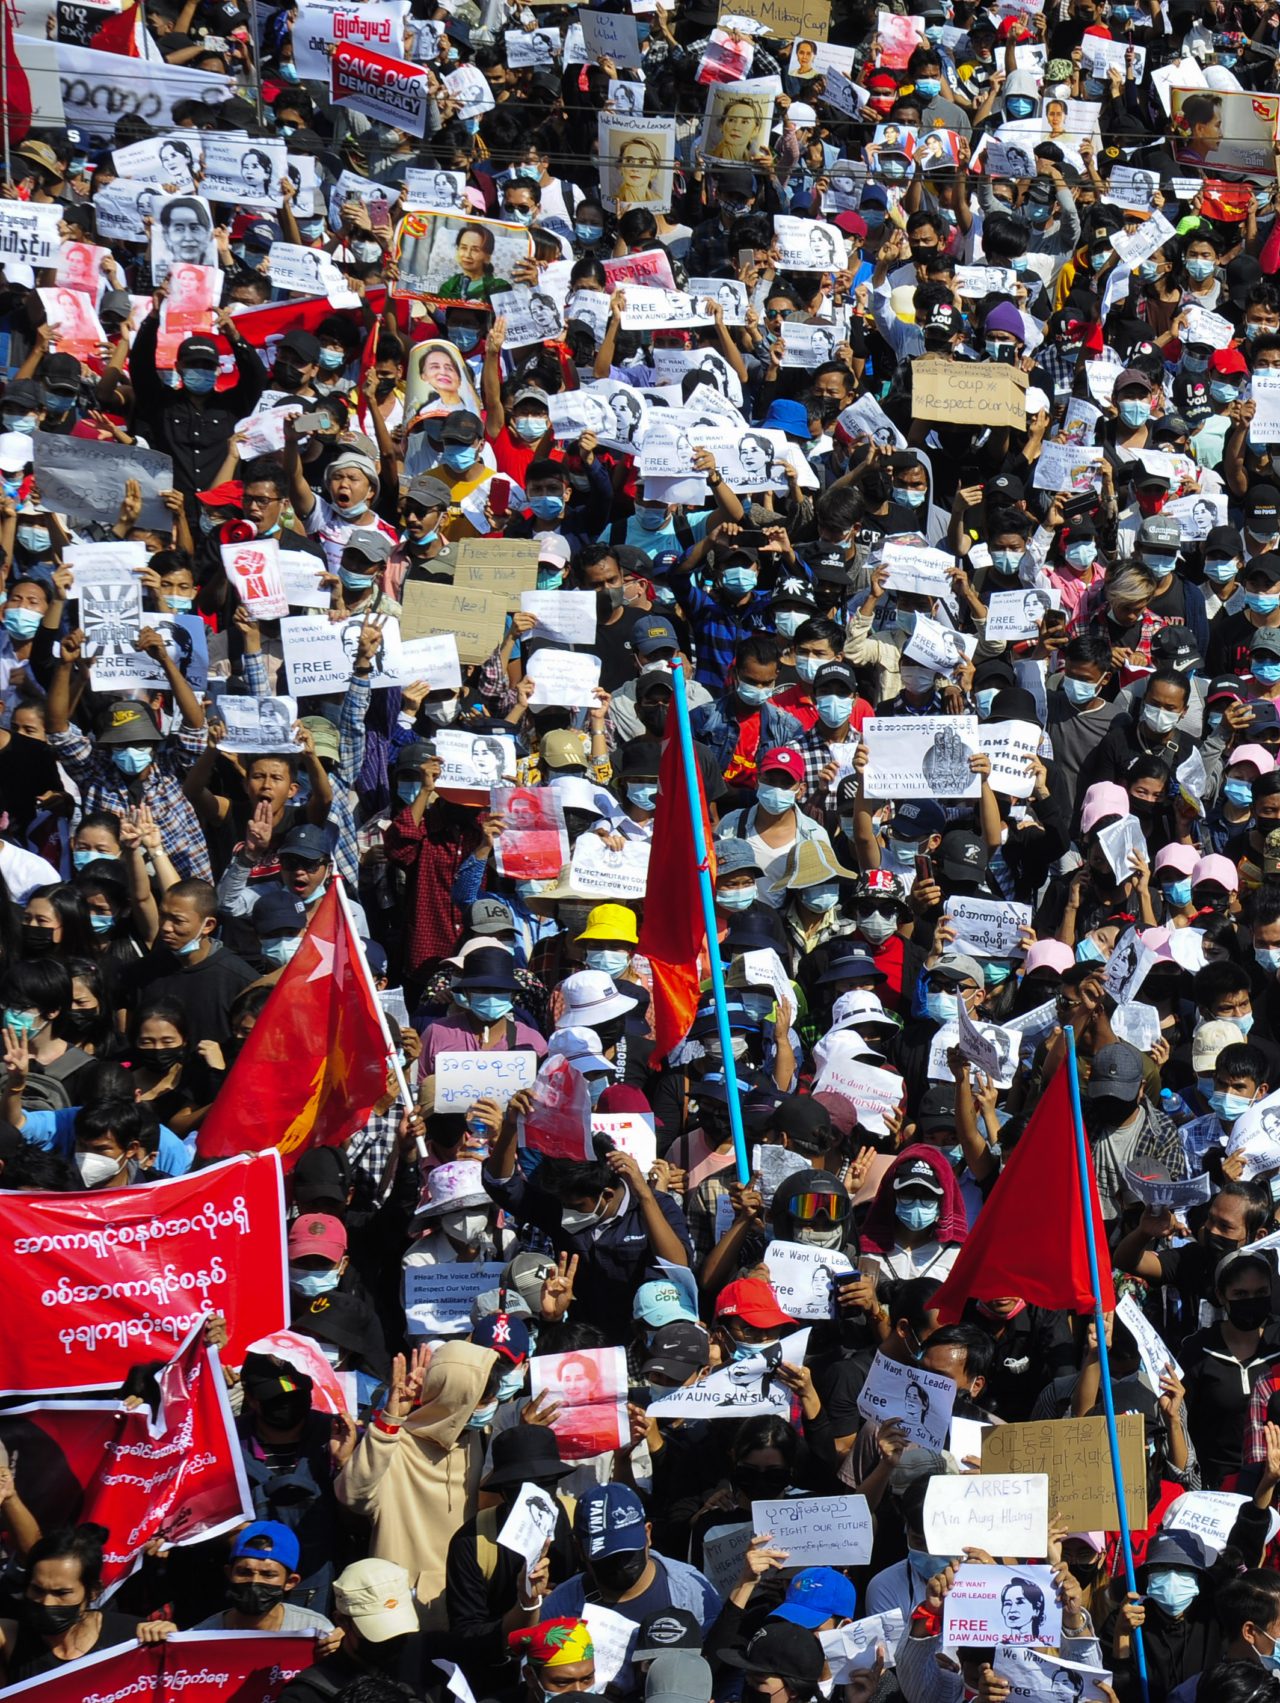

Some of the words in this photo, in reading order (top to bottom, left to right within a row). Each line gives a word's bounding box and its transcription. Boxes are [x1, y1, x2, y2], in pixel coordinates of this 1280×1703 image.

[339, 53, 382, 84] SAVE
[384, 69, 420, 98] OUR
[339, 72, 420, 115] DEMOCRACY
[100, 212, 128, 223] FREE
[605, 260, 658, 285] RESPECT
[625, 303, 655, 312] FREE
[931, 314, 951, 326] YOU
[978, 398, 1001, 411] Our
[644, 457, 668, 466] FREE
[452, 595, 487, 614] Need
[990, 616, 1014, 625] FREE
[288, 636, 304, 644] OUR
[305, 634, 337, 643] LEADER
[914, 633, 936, 651] FREE
[96, 657, 135, 669] FREE
[293, 660, 333, 674] FREE
[95, 669, 117, 679] DAW
[118, 668, 146, 679] AUNG
[294, 675, 316, 685] DAW
[318, 674, 345, 684] AUNG
[485, 905, 508, 919] Lee
[831, 1071, 846, 1086] We
[772, 1247, 785, 1259] We
[789, 1249, 810, 1263] Want
[814, 1252, 828, 1264] Our
[436, 1273, 448, 1281] The
[450, 1273, 468, 1281] Voice
[414, 1285, 444, 1293] #Respect
[883, 1360, 904, 1377] Want
[906, 1365, 921, 1382] Our
[923, 1369, 953, 1393] Leader
[686, 1391, 719, 1403] AUNG
[724, 1391, 748, 1403] SAN
[863, 1388, 888, 1408] Free
[896, 1421, 913, 1436] San
[915, 1426, 928, 1438] Su
[964, 1479, 1031, 1498] ARREST
[1183, 1509, 1221, 1529] FREE
[780, 1525, 808, 1537] FIGHT
[813, 1523, 832, 1533] OUR
[837, 1520, 869, 1531] FUTURE
[966, 1581, 986, 1589] WANT
[952, 1591, 966, 1599] OUR
[968, 1592, 998, 1600] LEADER
[950, 1620, 988, 1632] FREE
[950, 1633, 971, 1642] DAW
[973, 1633, 999, 1643] AUNG
[1001, 1633, 1021, 1643] SAN
[1039, 1634, 1055, 1643] KYI
